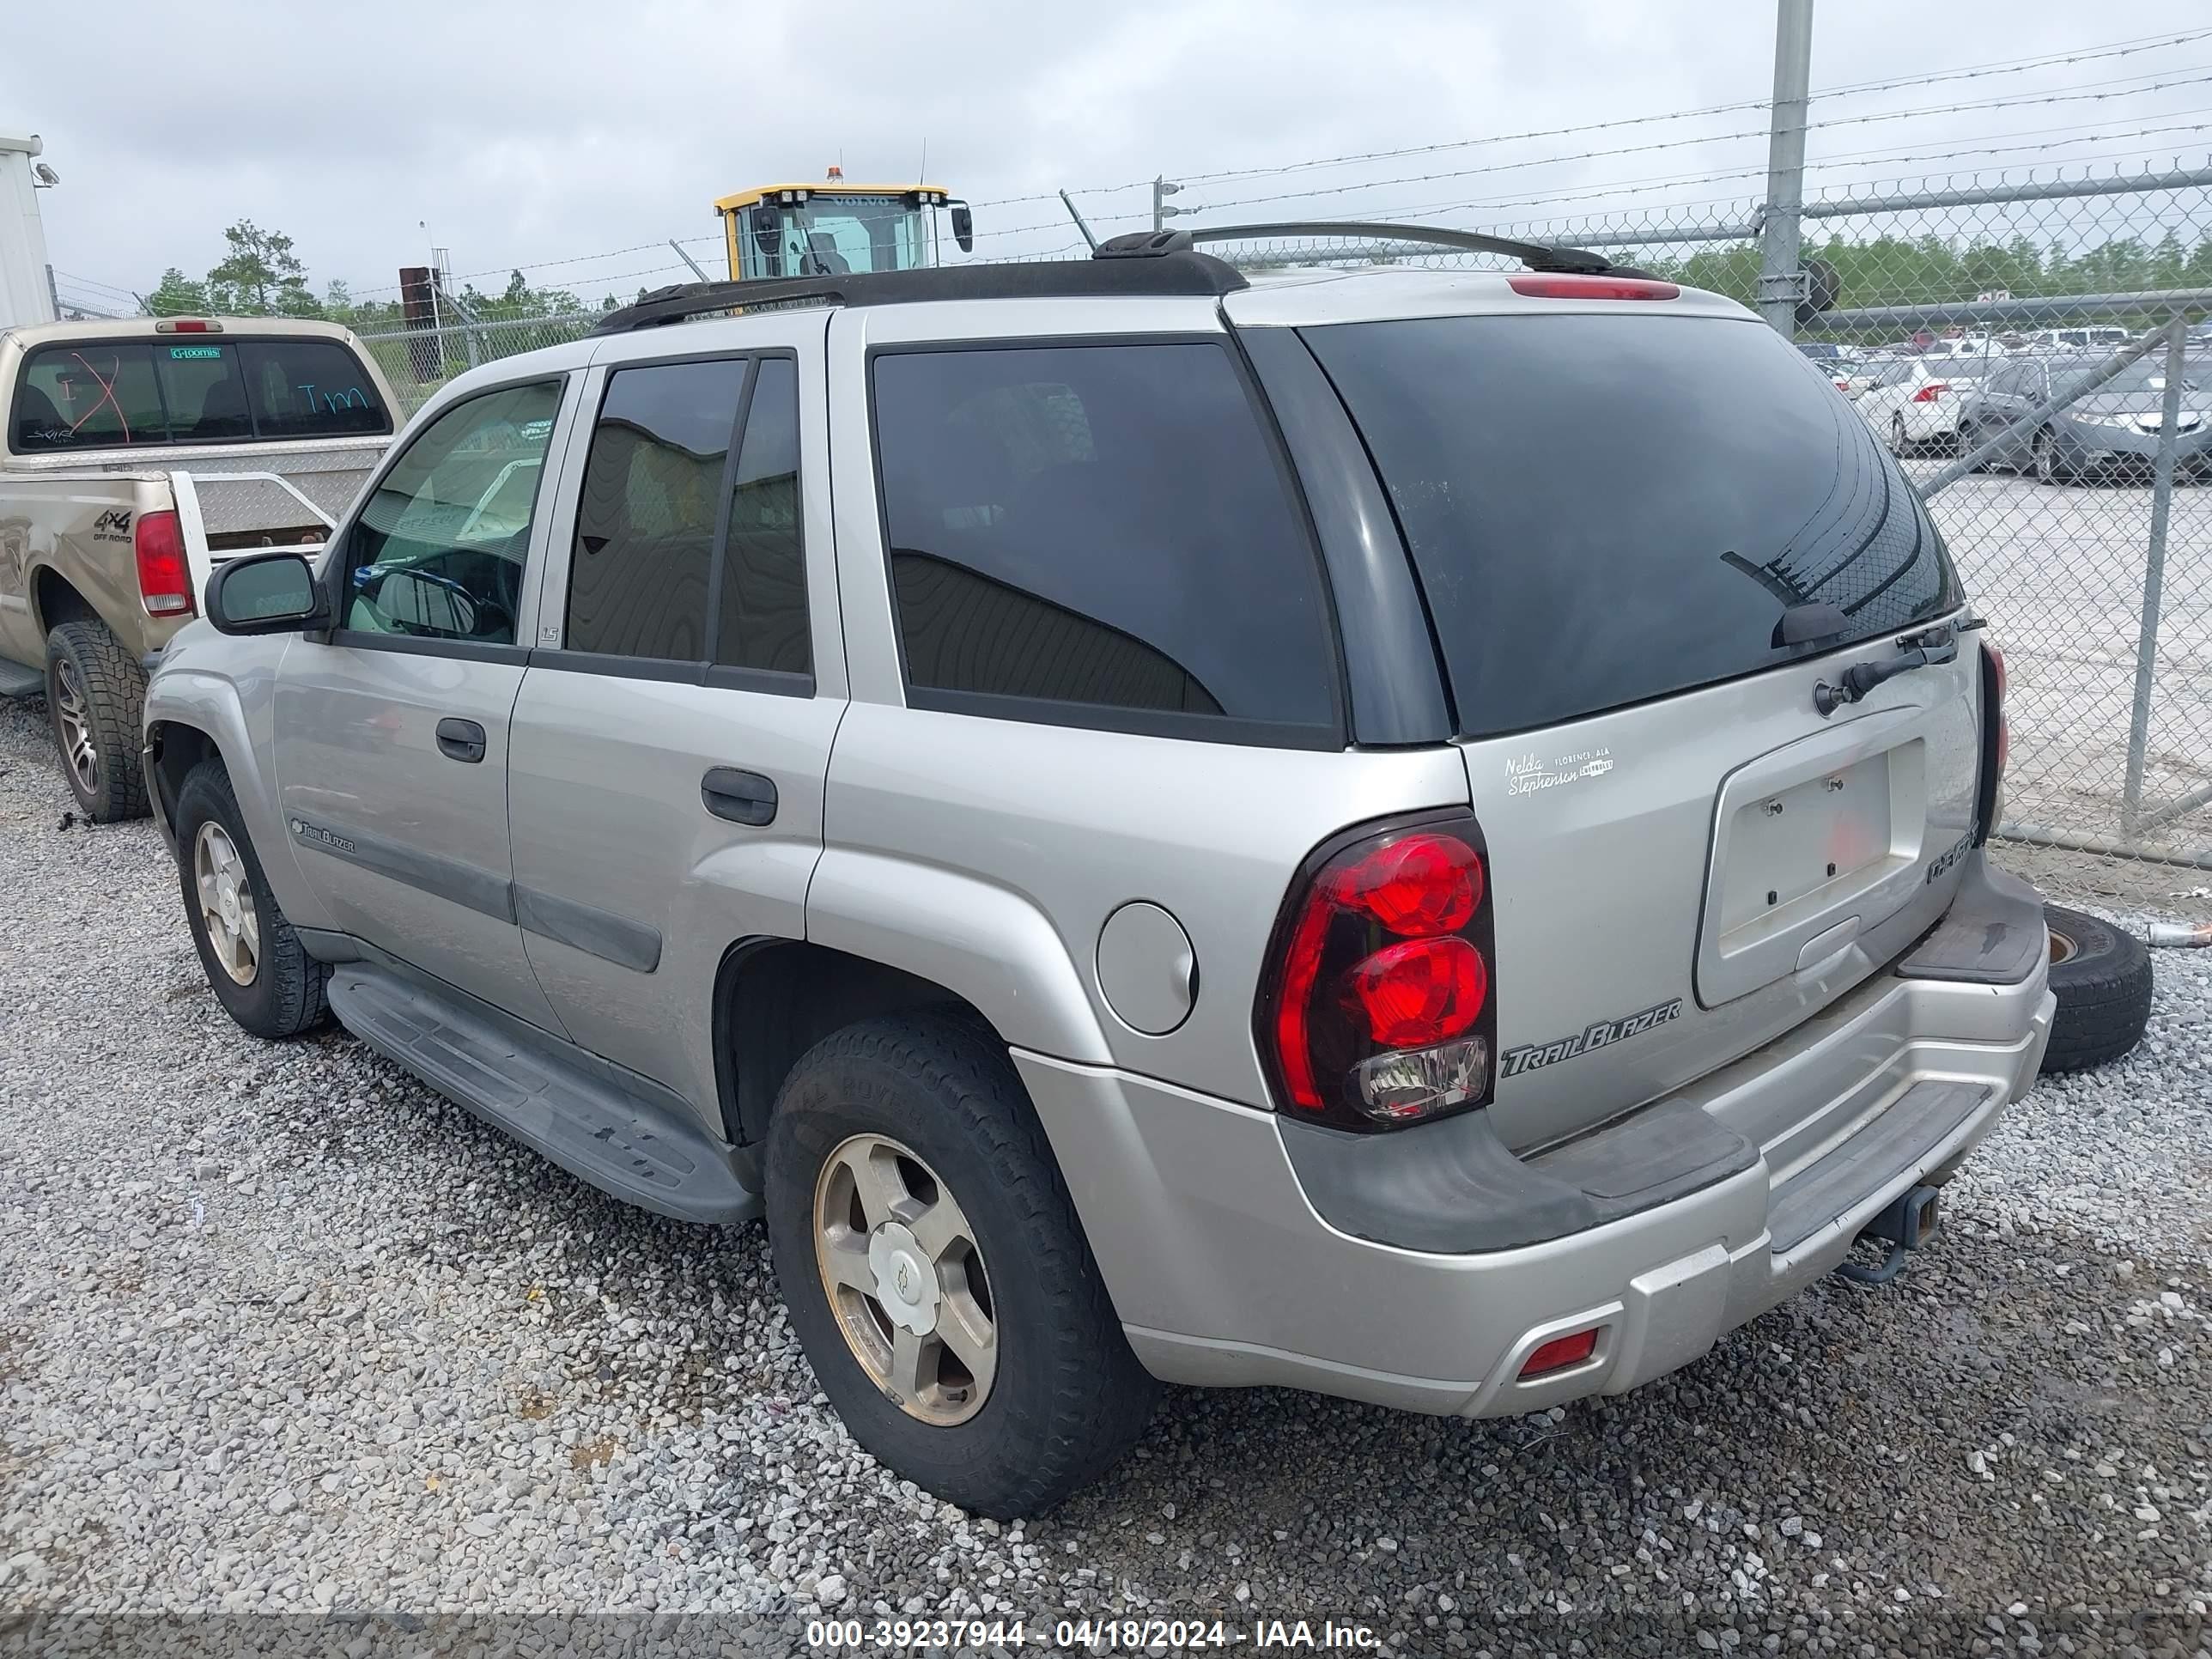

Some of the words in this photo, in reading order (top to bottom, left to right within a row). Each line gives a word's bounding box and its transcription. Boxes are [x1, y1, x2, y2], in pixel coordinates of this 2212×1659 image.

[834, 198, 890, 207] VOLVO
[93, 533, 108, 542] OFF
[109, 534, 132, 544] ROAD
[540, 627, 559, 642] LS
[1504, 752, 1544, 777] Nelda
[1508, 771, 1579, 798] Stephenson
[301, 820, 357, 854] TRAILBLAZER
[1501, 997, 1683, 1079] TRAILBLAZER
